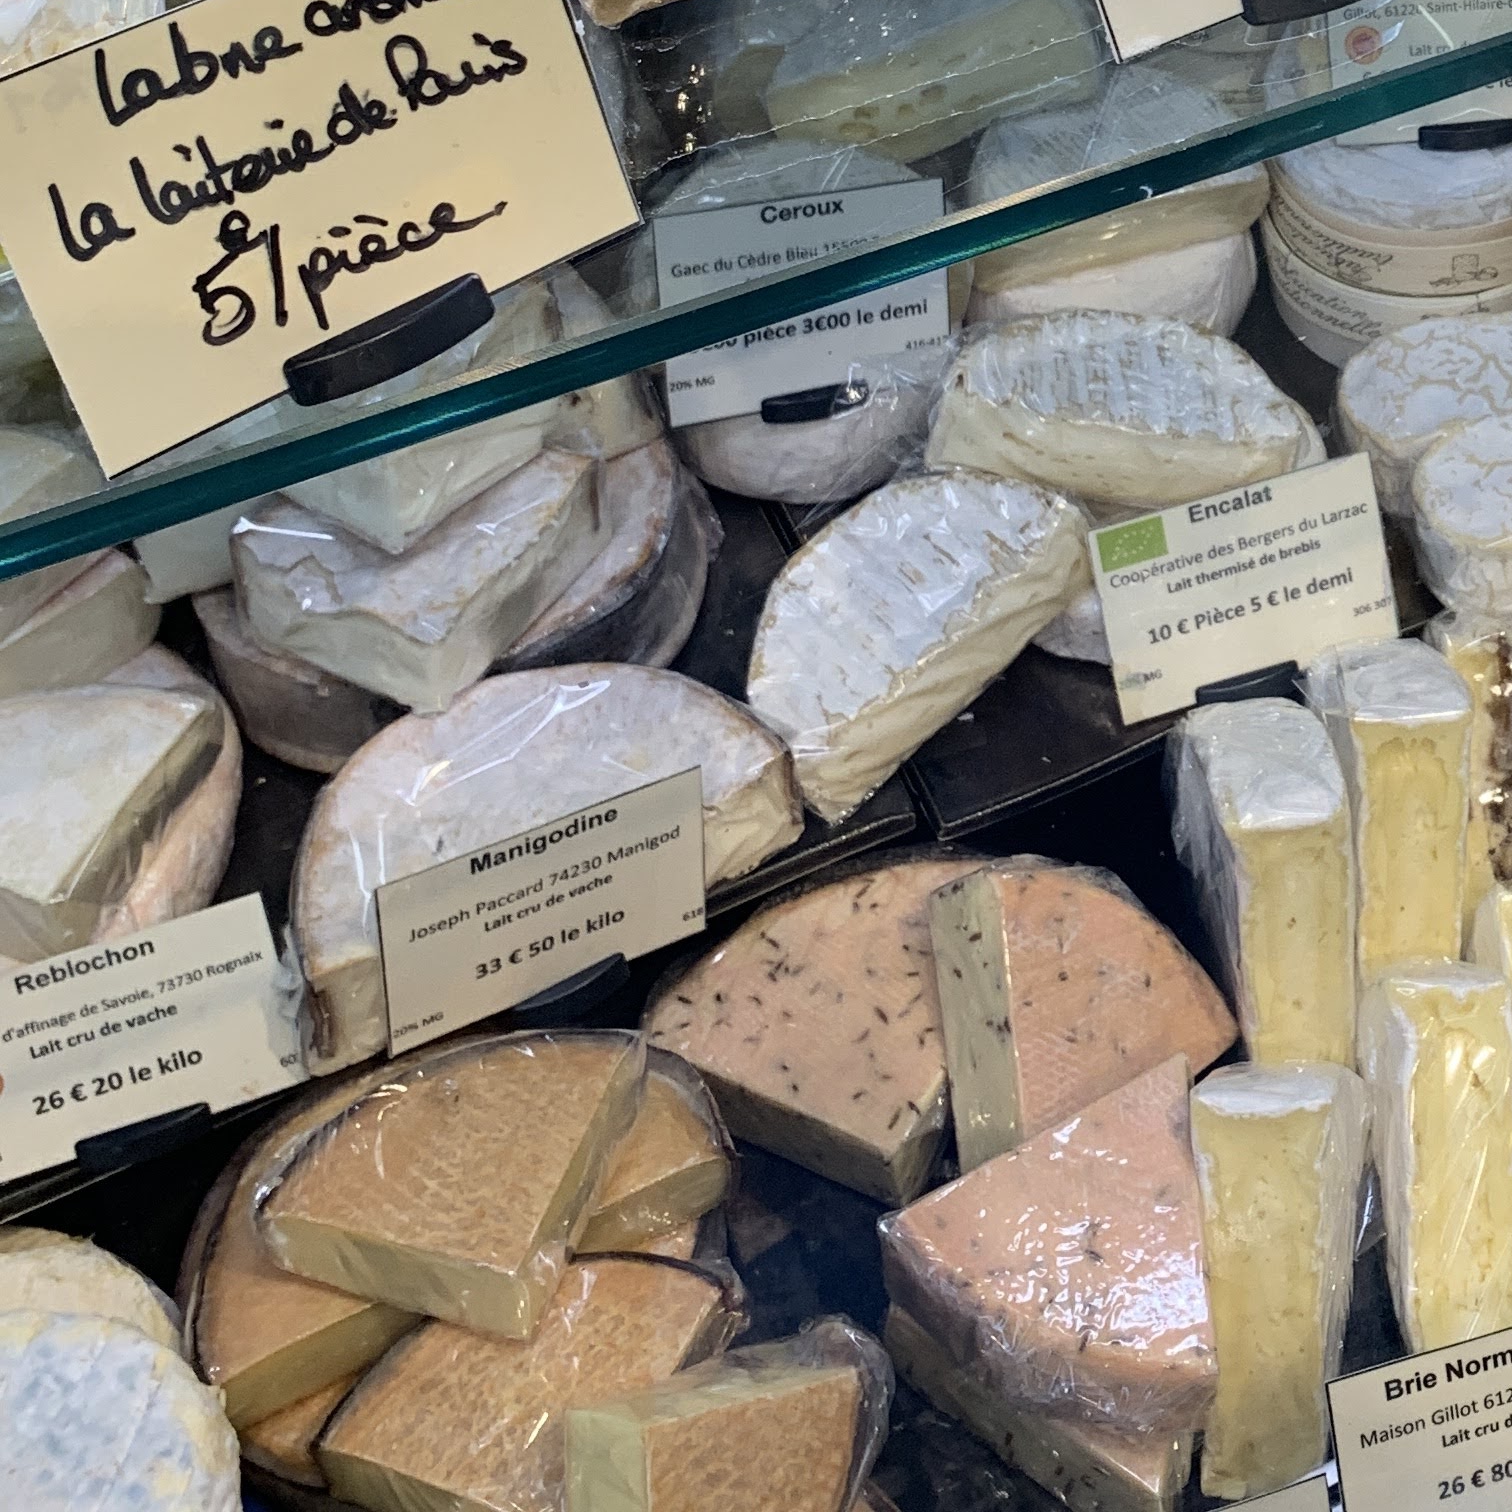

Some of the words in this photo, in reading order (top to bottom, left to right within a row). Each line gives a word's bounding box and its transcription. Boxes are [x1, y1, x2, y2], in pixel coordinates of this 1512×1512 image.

[96, 21, 303, 126] Labne
[326, 81, 399, 147] de
[385, 32, 528, 111] Paris
[760, 199, 845, 225] Ceroux
[671, 263, 709, 278] Gaec
[714, 258, 733, 272] du
[737, 252, 782, 268] Cèdre
[744, 320, 797, 348] pièce
[802, 312, 851, 335] 3€00
[857, 309, 875, 325] le
[880, 299, 928, 322] demi
[1188, 486, 1272, 523] Encalat
[1110, 551, 1203, 589] Coopérative
[1208, 544, 1234, 558] des
[1237, 526, 1295, 551] Bergers
[1298, 517, 1318, 532] du
[1321, 501, 1368, 526] Larzac
[469, 807, 619, 875] Manigodine
[408, 910, 471, 942] Joseph
[475, 879, 543, 915] Paccard
[549, 856, 602, 886] 74230
[606, 825, 681, 864] Manigod
[14, 940, 155, 995] Reblochon
[32, 1090, 65, 1115] 26
[71, 1083, 88, 1102] €
[92, 1073, 123, 1096] 20
[129, 1065, 153, 1084] le
[157, 1048, 203, 1075] kilo
[1384, 1370, 1438, 1401] Brie
[1360, 1417, 1426, 1449] Maison
[1432, 1398, 1480, 1426] Gillot
